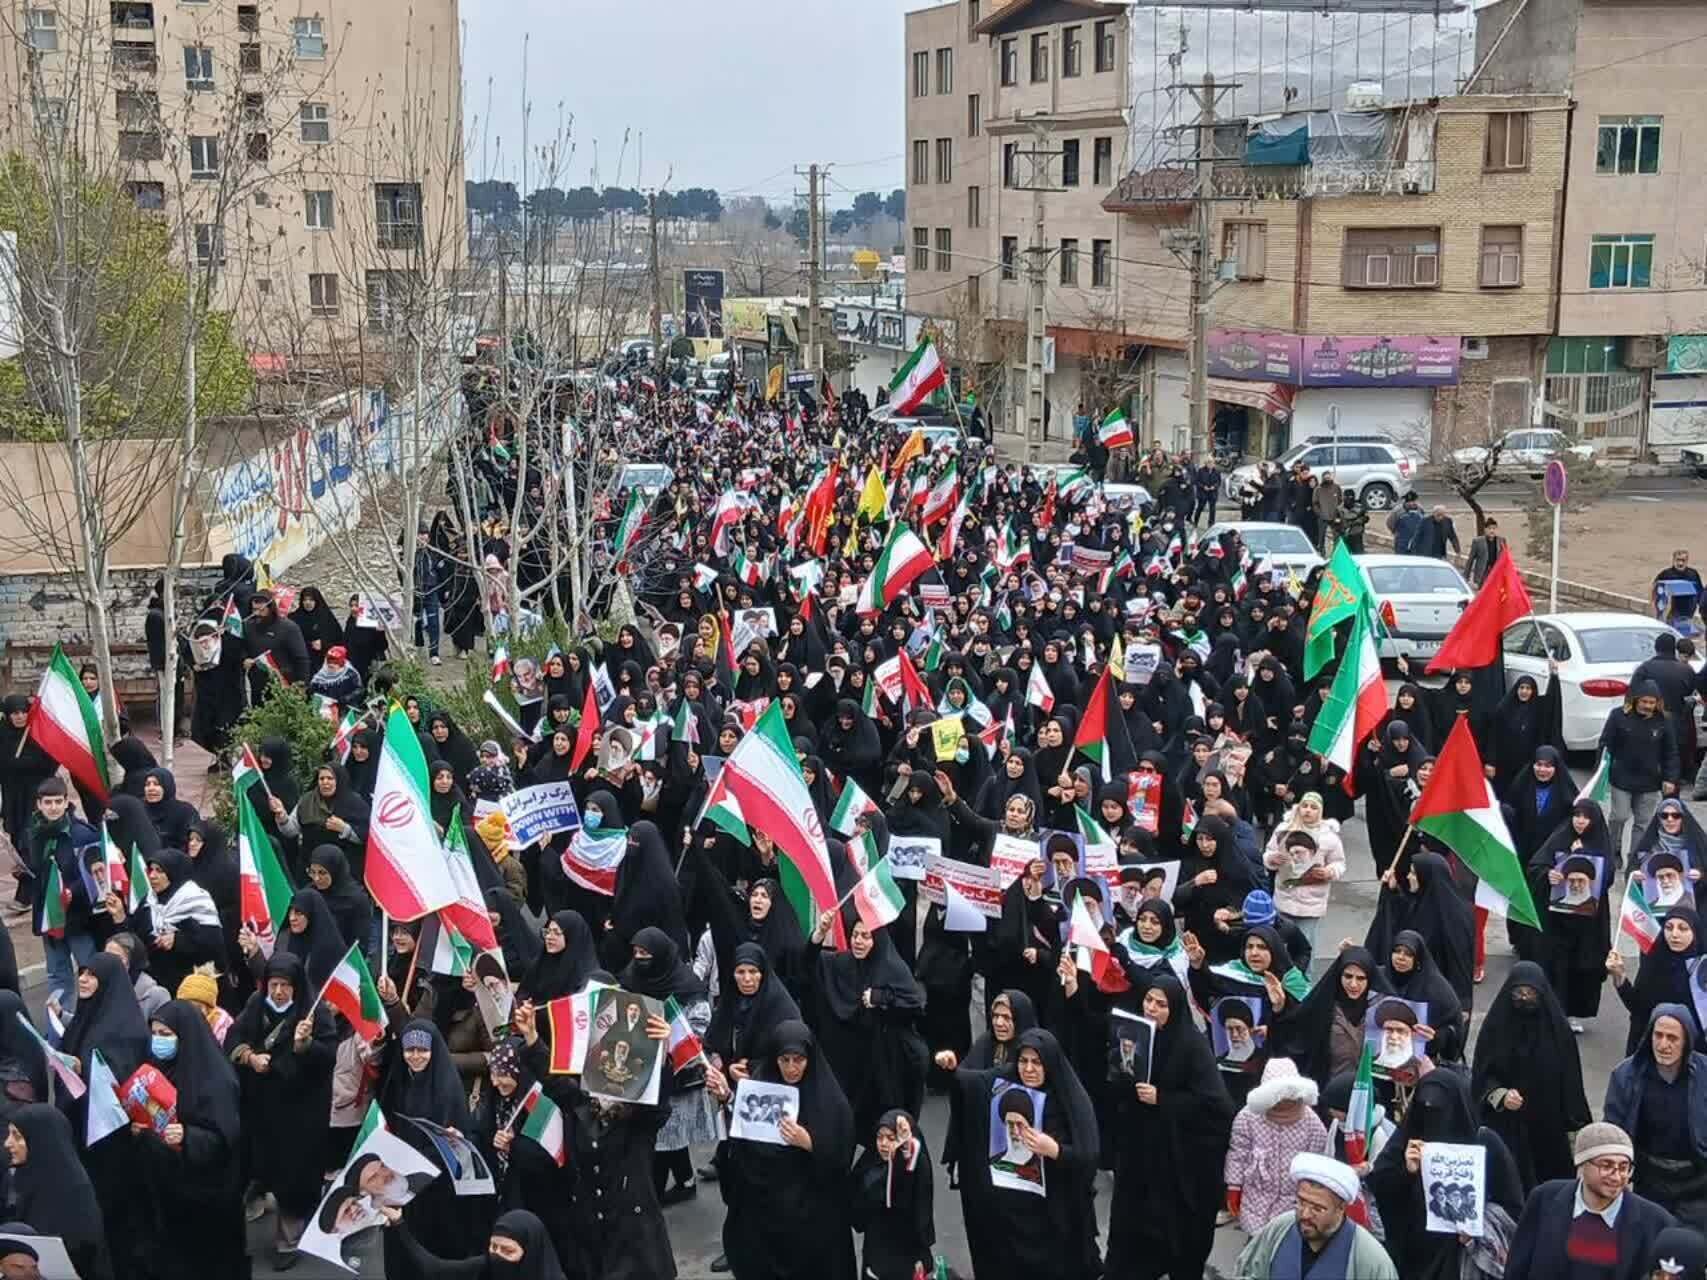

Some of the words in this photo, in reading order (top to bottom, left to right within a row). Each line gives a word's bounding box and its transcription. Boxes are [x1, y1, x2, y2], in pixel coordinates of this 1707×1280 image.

[538, 791, 548, 805] بر
[549, 787, 570, 801] مرگ
[512, 811, 543, 832] DOWN
[543, 806, 575, 818] WITH
[527, 818, 561, 836] ISRAEL
